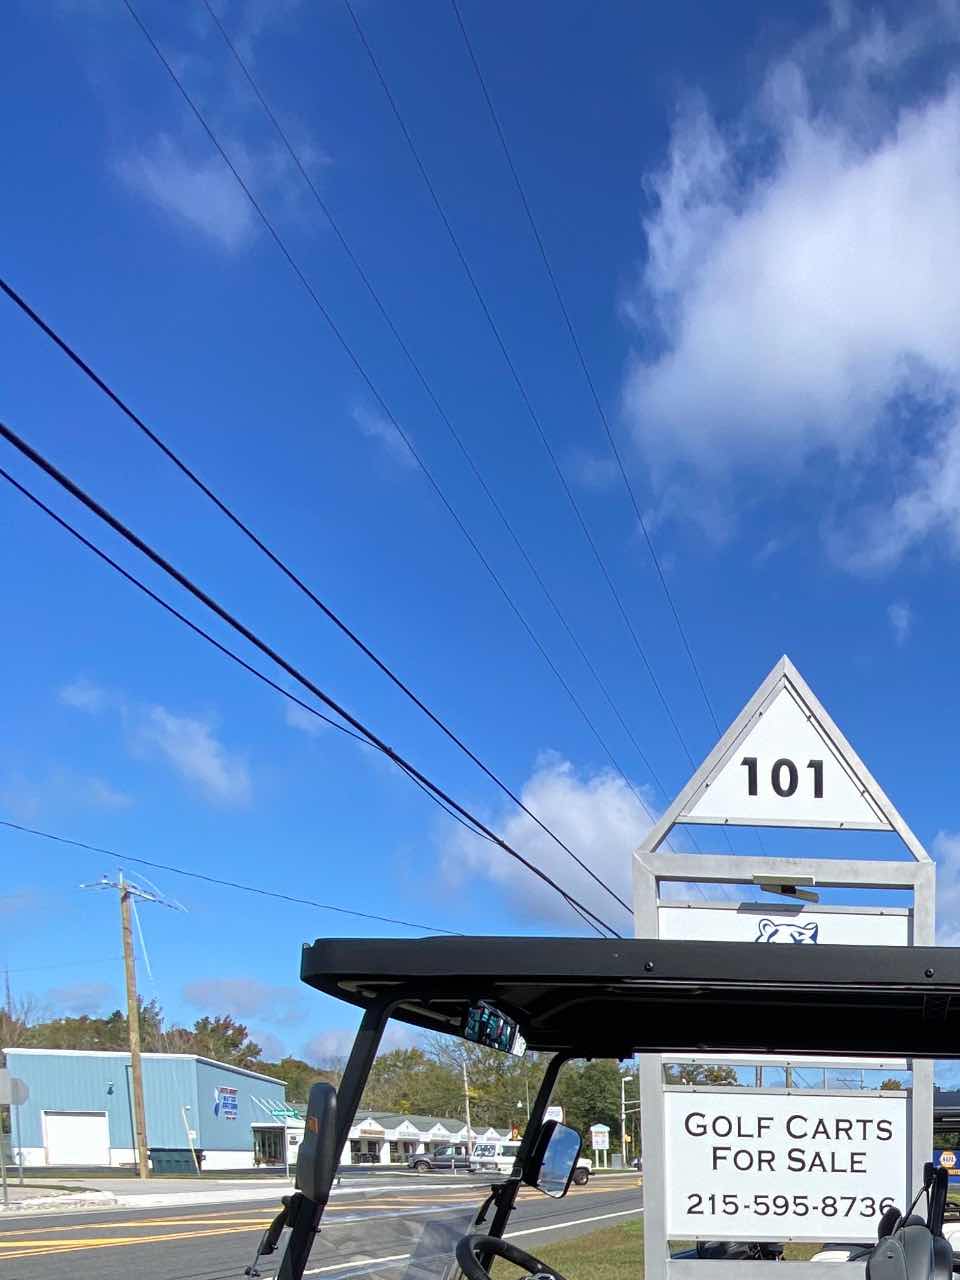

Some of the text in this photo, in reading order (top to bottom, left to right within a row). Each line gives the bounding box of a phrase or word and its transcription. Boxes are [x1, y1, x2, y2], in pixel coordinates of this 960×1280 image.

[740, 756, 824, 799] 101
[684, 1111, 893, 1141] GOLF CARTS
[712, 1146, 867, 1174] FOR SALE
